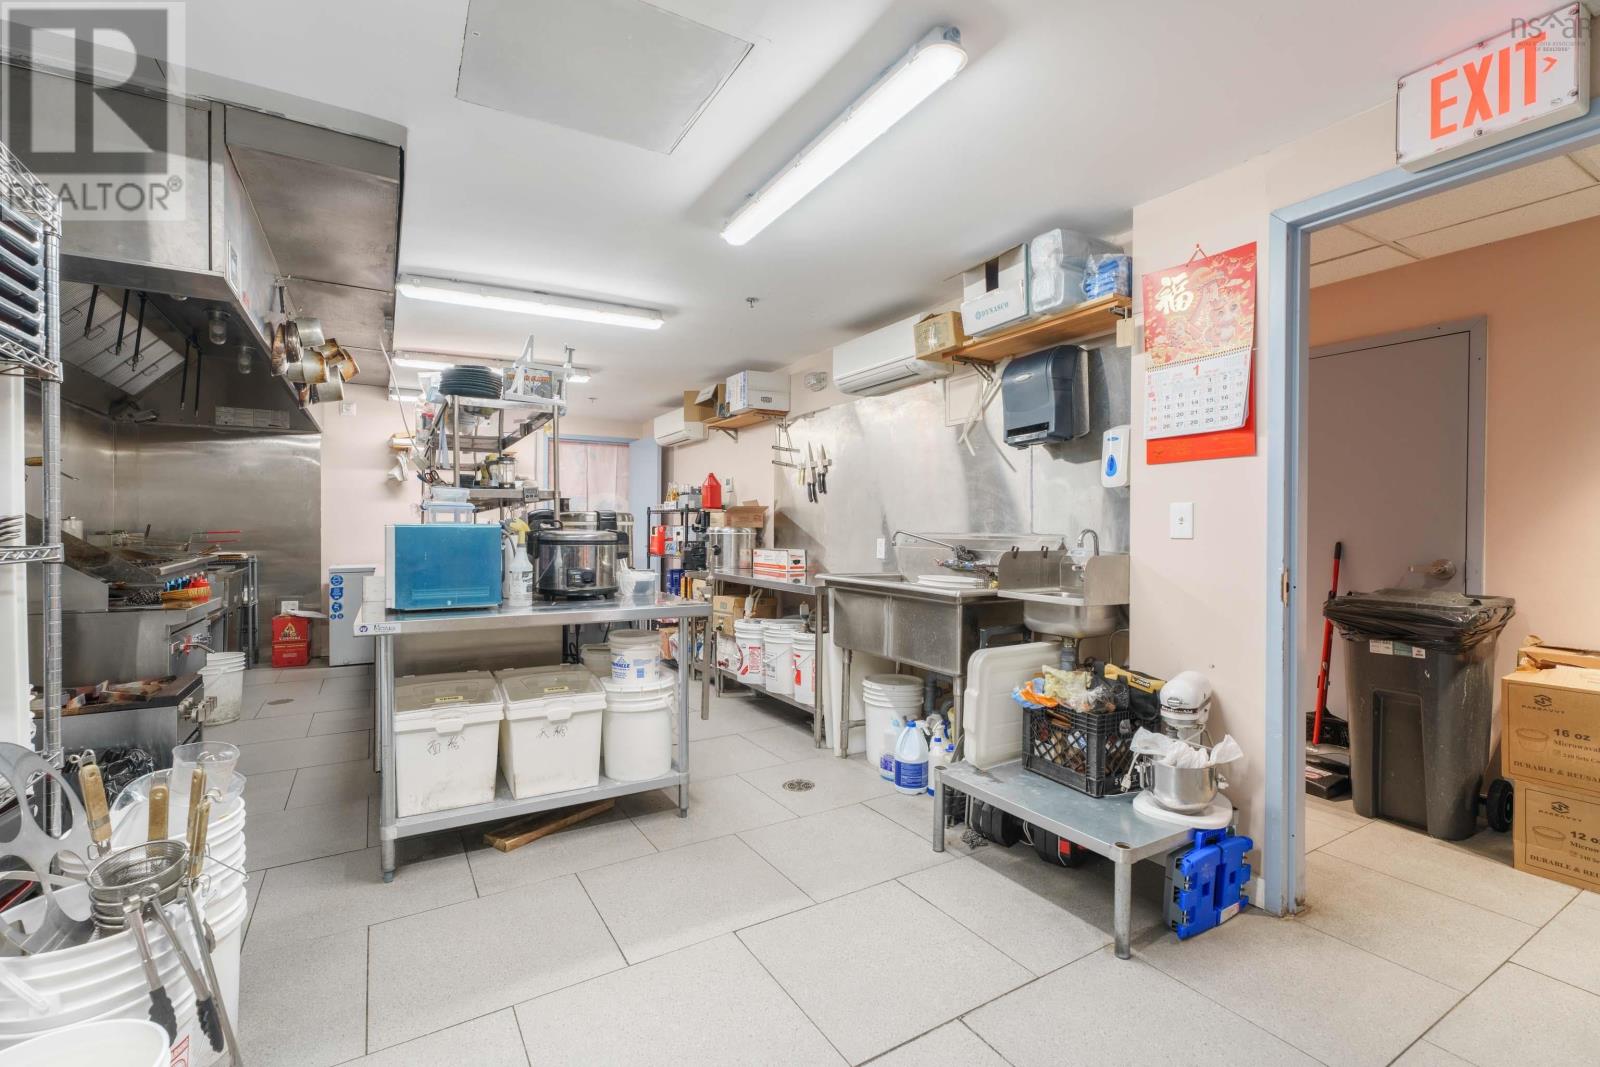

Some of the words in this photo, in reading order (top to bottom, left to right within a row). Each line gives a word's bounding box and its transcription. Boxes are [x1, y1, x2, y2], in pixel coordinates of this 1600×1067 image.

[1430, 31, 1546, 140] EXIT
[1155, 271, 1194, 315] 福
[1193, 364, 1200, 376] 1
[1553, 728, 1570, 737] 16
[1574, 733, 1591, 741] oz
[1513, 760, 1555, 775] DURABLE
[1570, 830, 1586, 841] 12
[1590, 837, 1600, 845] o
[1529, 854, 1571, 872] DURABLE
